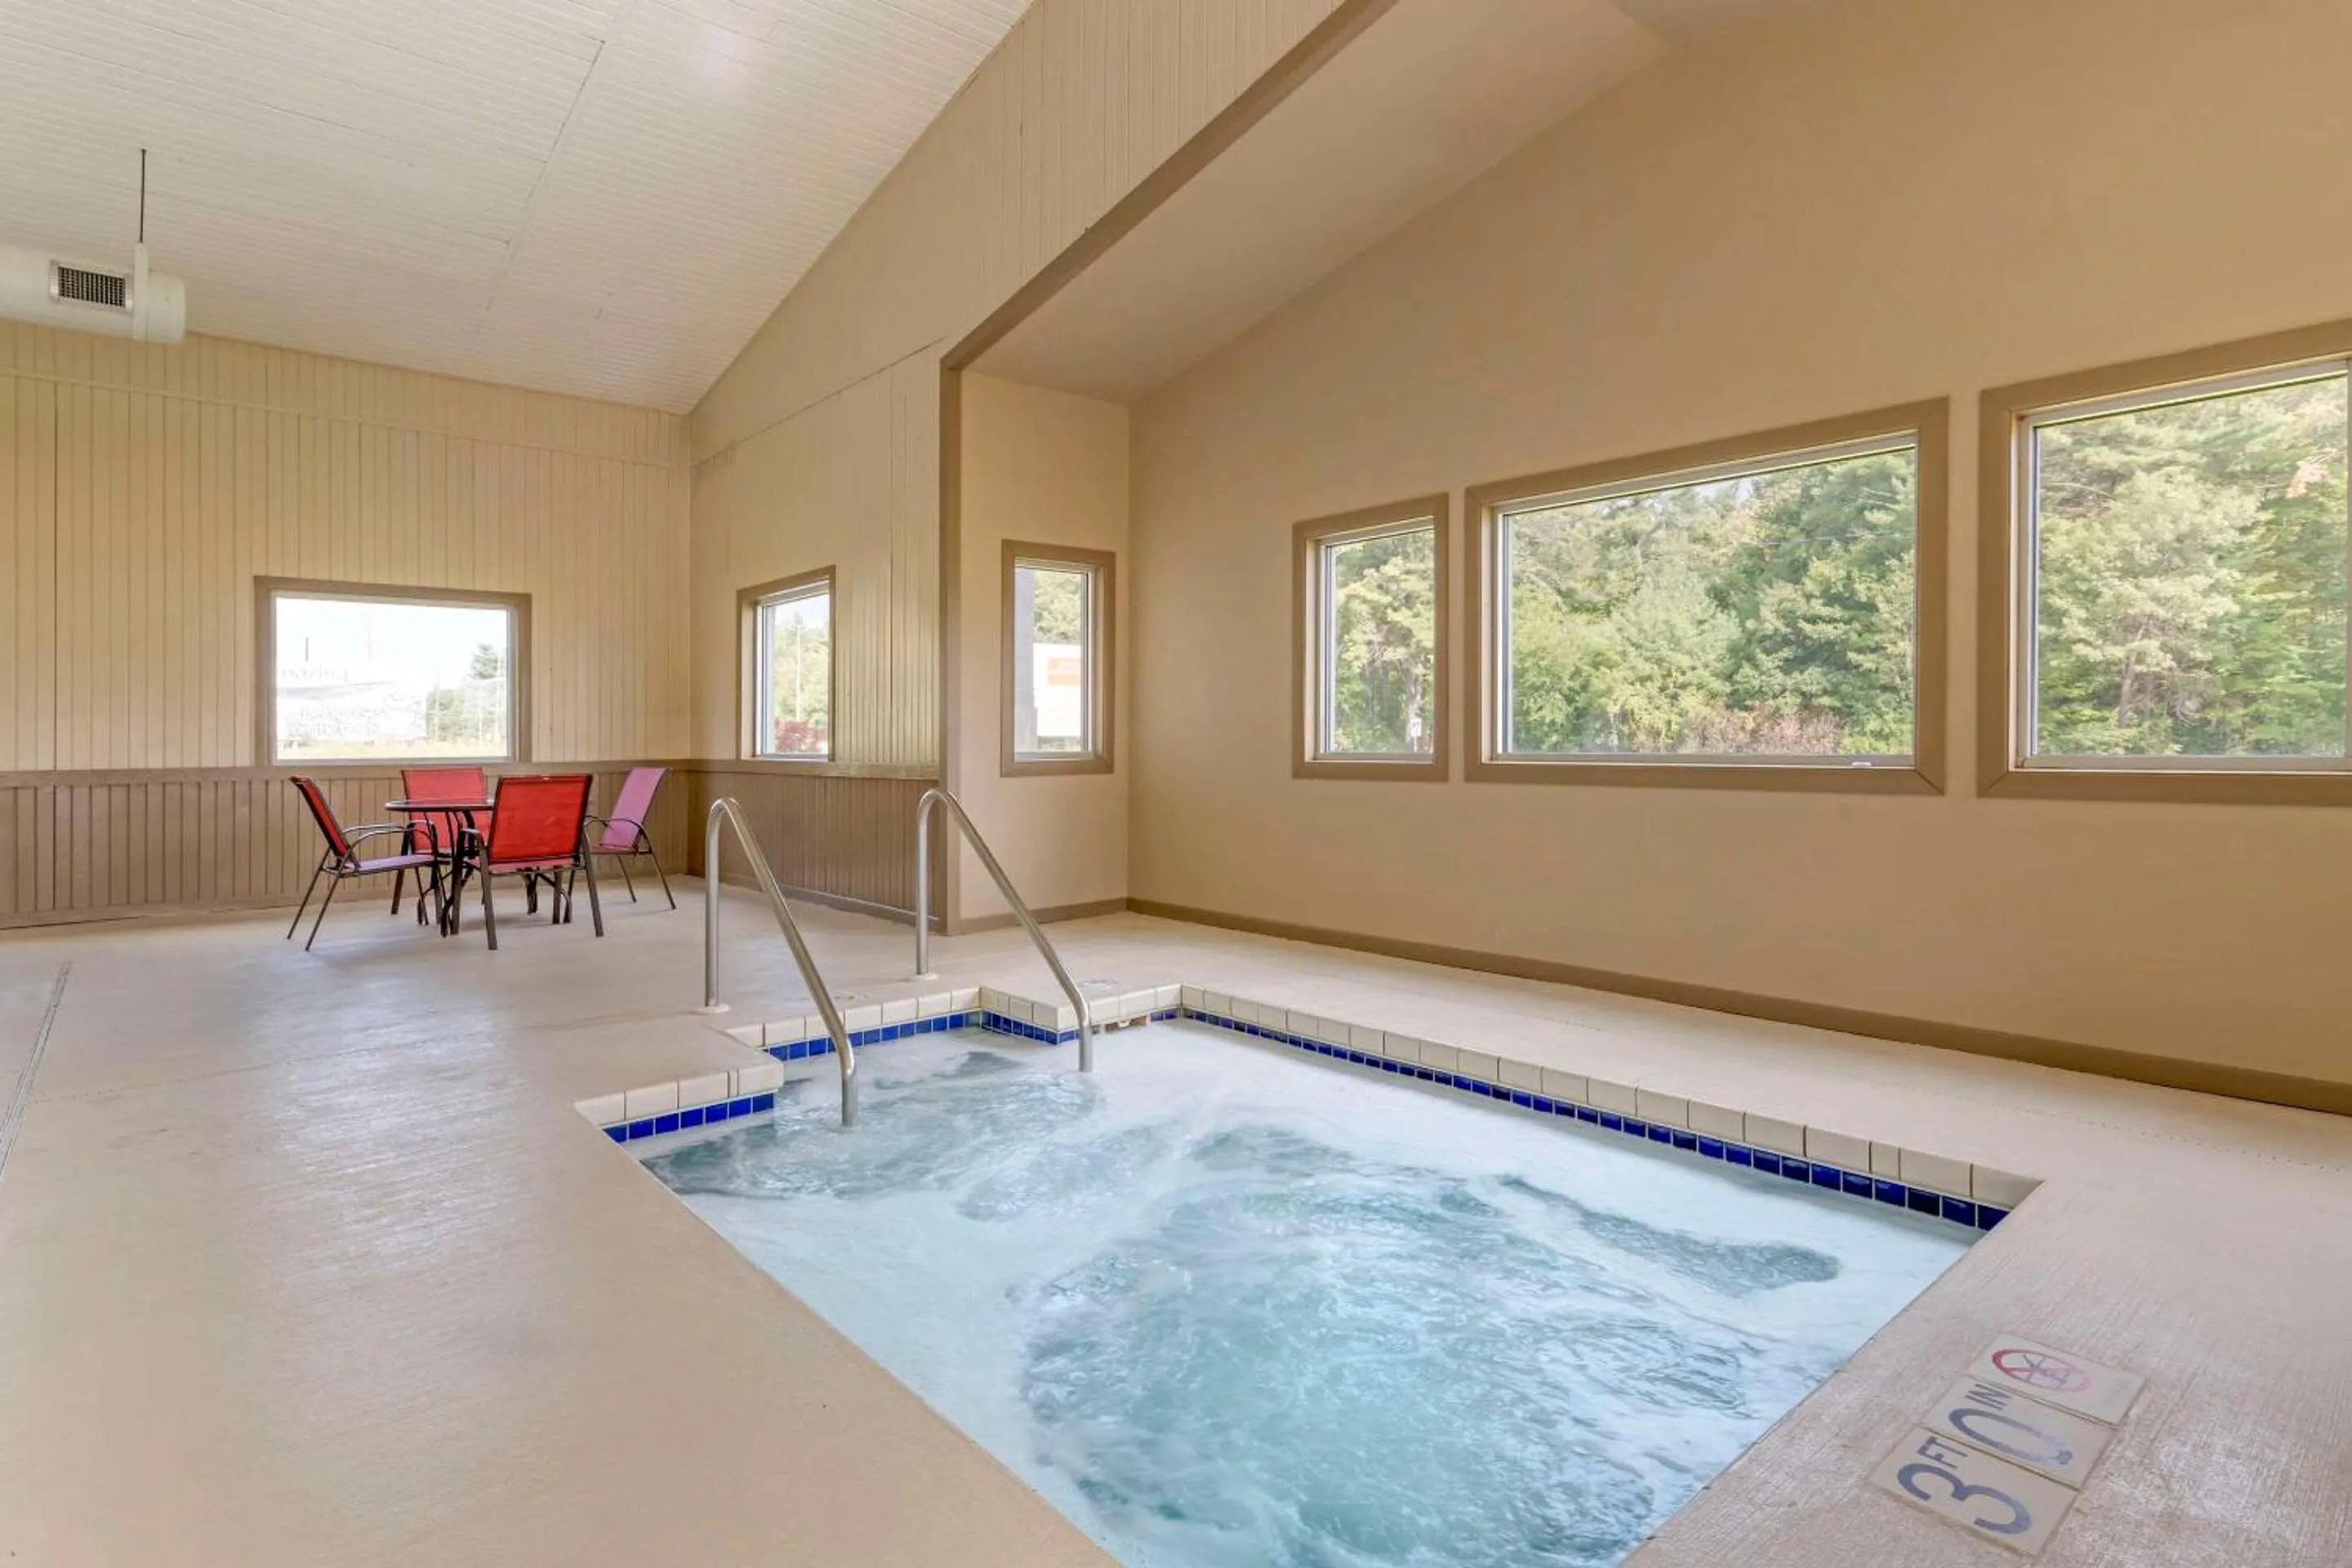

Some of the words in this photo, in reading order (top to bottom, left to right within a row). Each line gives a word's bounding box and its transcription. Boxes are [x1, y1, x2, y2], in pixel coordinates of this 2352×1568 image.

[1965, 1383, 2012, 1410] IN
[1918, 1437, 1969, 1468] FT
[1949, 1408, 2073, 1465] 0
[1897, 1463, 2031, 1535] 3
